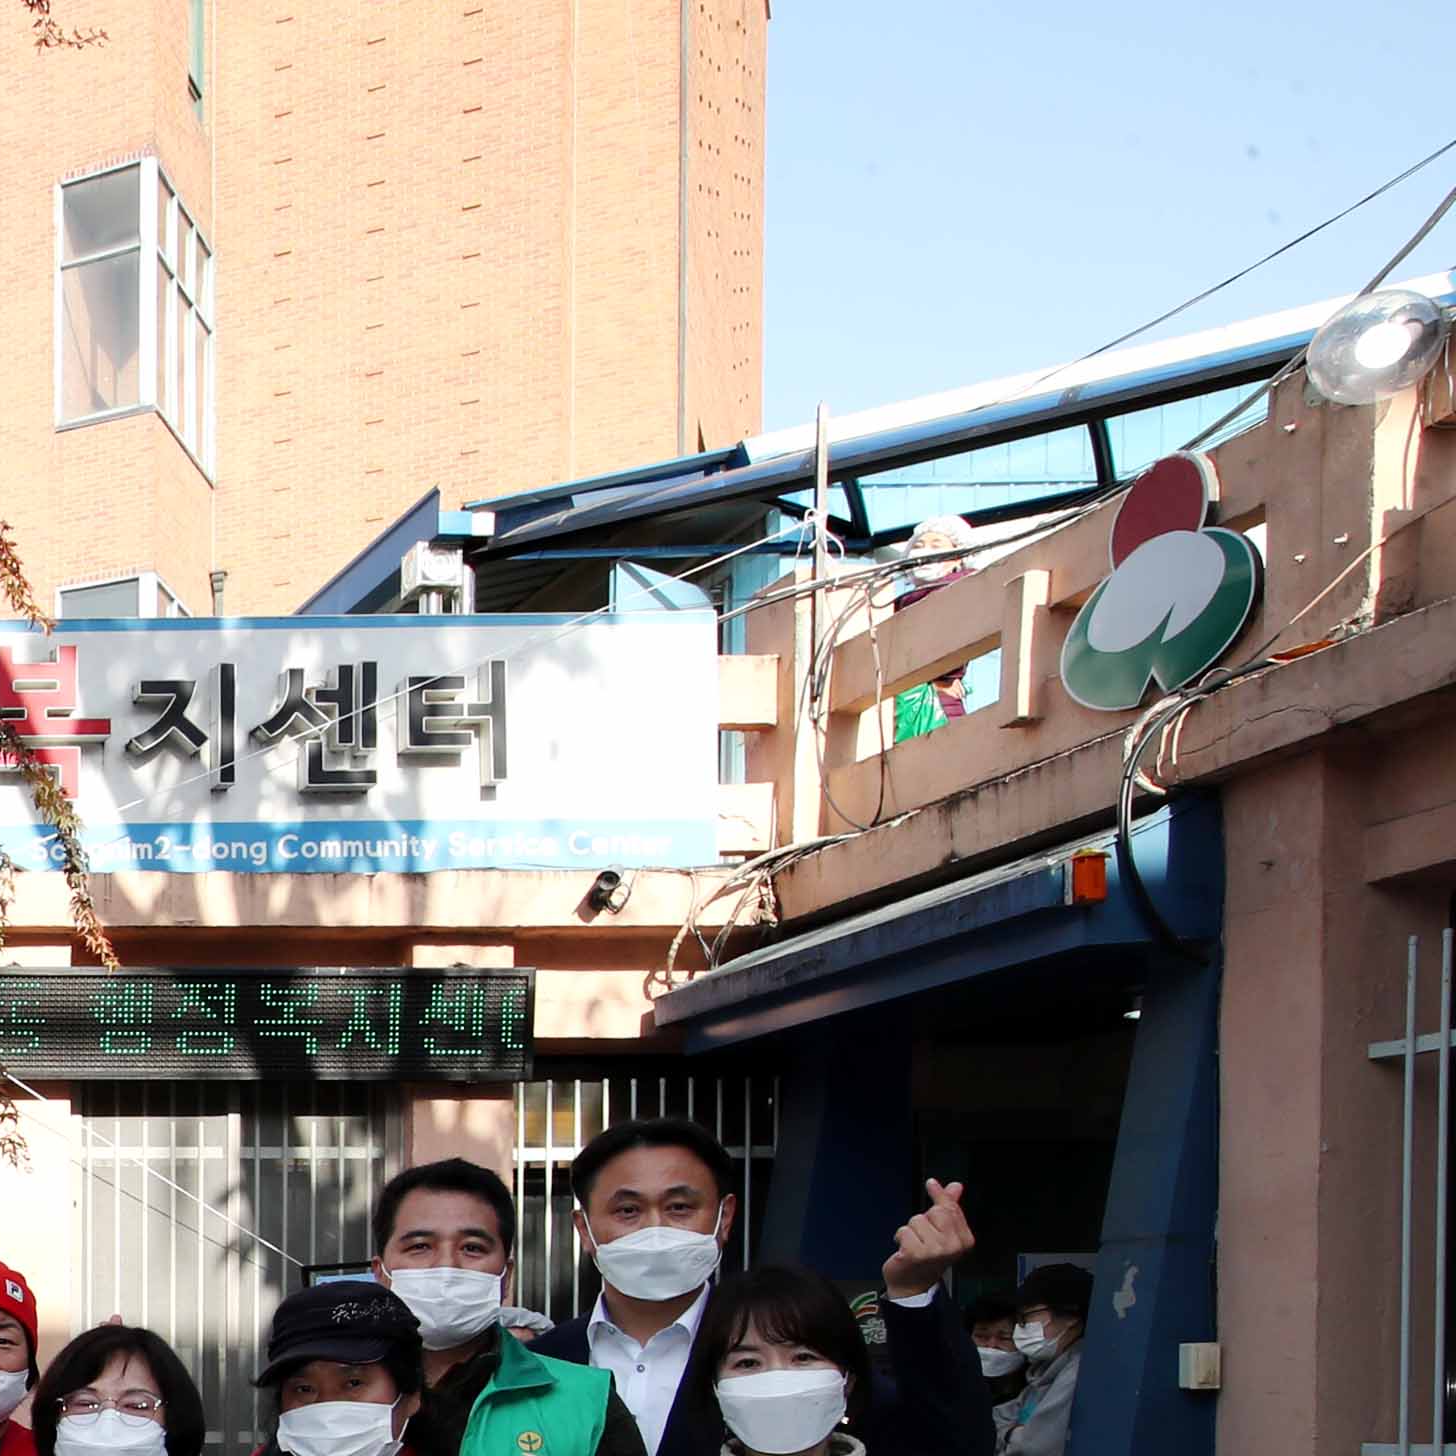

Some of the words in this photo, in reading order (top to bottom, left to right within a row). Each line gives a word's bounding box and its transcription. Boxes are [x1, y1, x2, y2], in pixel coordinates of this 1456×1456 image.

[278, 833, 438, 861] Community
[448, 832, 560, 858] Service
[568, 831, 673, 858] Center
